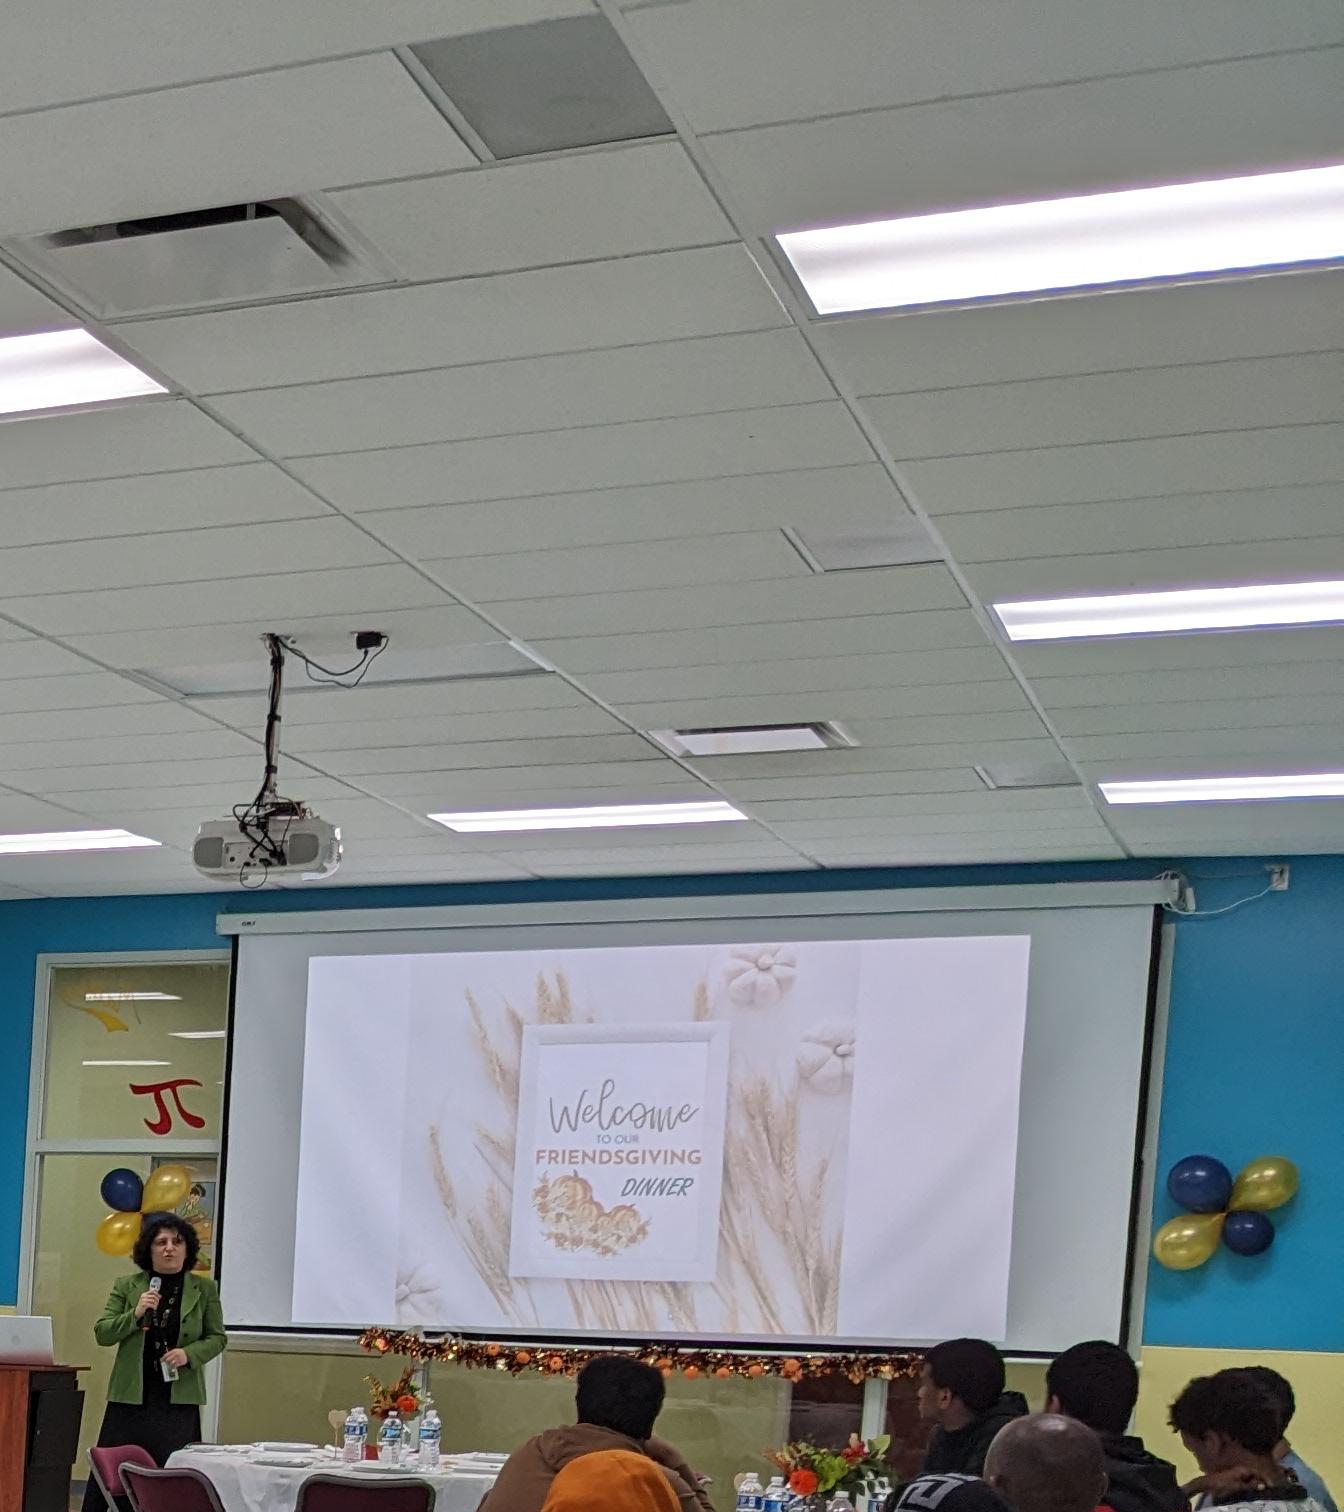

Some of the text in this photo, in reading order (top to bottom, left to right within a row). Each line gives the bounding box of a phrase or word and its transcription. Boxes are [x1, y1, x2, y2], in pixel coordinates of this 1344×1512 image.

[549, 1079, 699, 1133] Welcome
[597, 1135, 639, 1144] TO OUR
[535, 1149, 702, 1165] FRIENDSGIVING
[621, 1177, 694, 1197] DINNER
